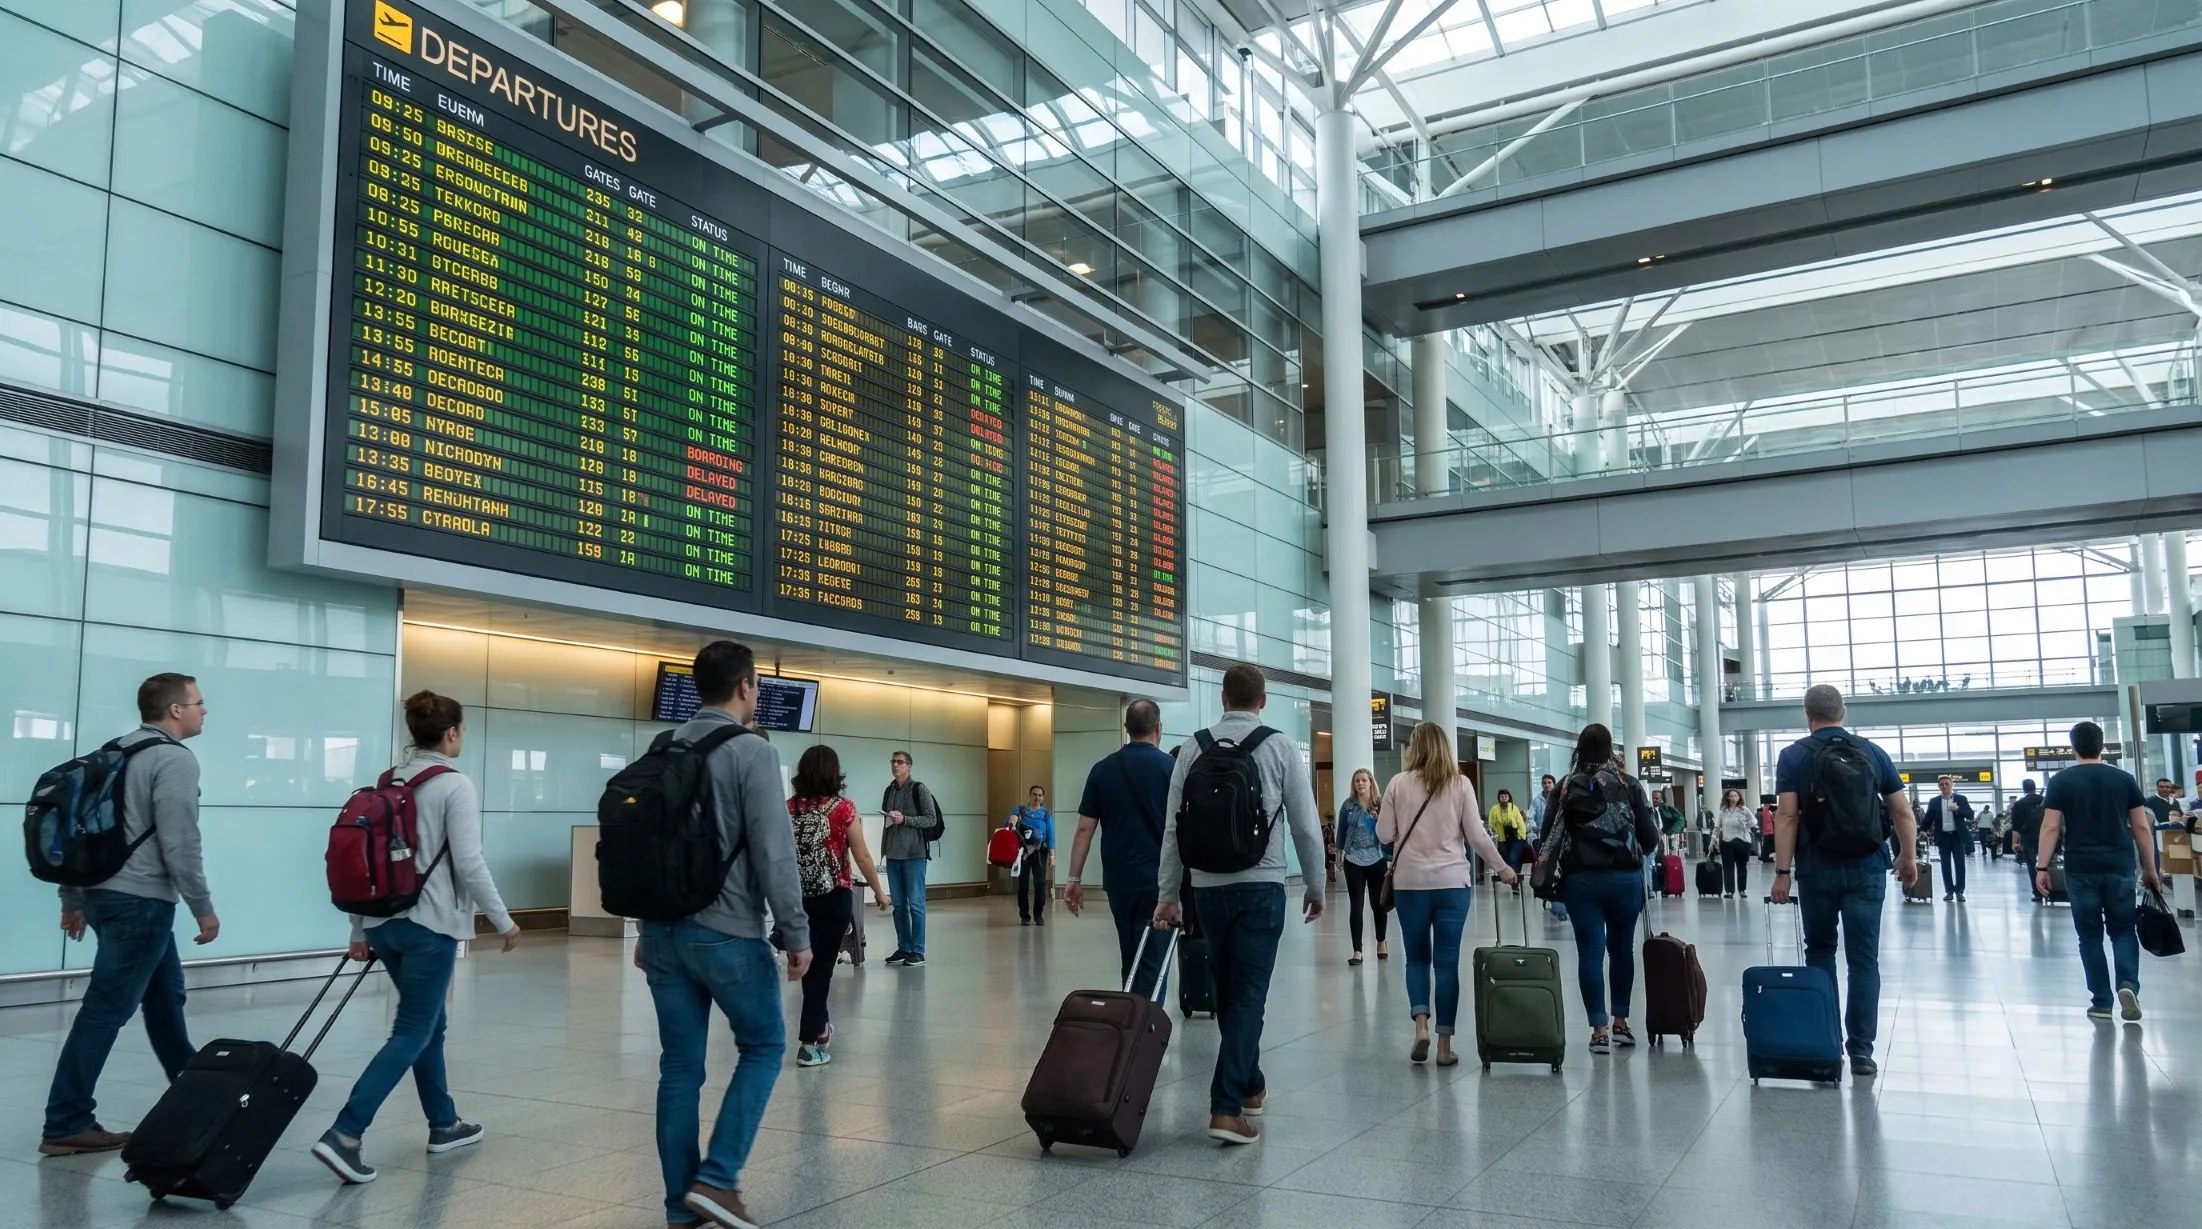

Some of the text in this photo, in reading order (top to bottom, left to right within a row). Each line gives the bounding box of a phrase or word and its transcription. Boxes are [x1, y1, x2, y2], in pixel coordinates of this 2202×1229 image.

[421, 26, 637, 163] DEPARTURES
[372, 61, 728, 242] TIME GATES GATE STATUS
[586, 188, 610, 209] 235
[627, 206, 643, 224] 32
[692, 236, 707, 253] ON
[713, 245, 739, 267] TIME
[691, 255, 706, 271] ON
[712, 264, 738, 286] TIME
[366, 231, 417, 261] 10:31
[689, 350, 704, 366] ON
[711, 357, 737, 378] TIME
[366, 254, 417, 284] 11:30
[689, 369, 704, 385] ON
[710, 376, 737, 397] TIME
[368, 207, 419, 238] 10:55
[689, 330, 705, 347] ON
[711, 338, 738, 360] TIME
[585, 270, 609, 289] 150
[690, 312, 705, 328] ON
[712, 320, 738, 341] TIME
[690, 293, 706, 309] ON
[712, 301, 738, 323] TIME
[691, 274, 706, 291] ON
[712, 282, 738, 304] TIME
[783, 258, 807, 279] TIME
[933, 330, 953, 347] GATE
[970, 347, 995, 366] STATUS
[363, 326, 414, 353] 13:55
[581, 394, 605, 412] 133
[688, 427, 703, 443] ON
[709, 433, 736, 453] TIME
[364, 302, 415, 330] 13:55
[581, 373, 606, 391] 238
[688, 407, 703, 423] ON
[709, 414, 736, 434] TIME
[365, 278, 416, 307] 12:20
[688, 388, 704, 404] ON
[710, 395, 737, 415] TIME
[358, 447, 409, 472] 13:35
[685, 524, 701, 539] ON
[707, 528, 735, 547] TIME
[686, 485, 736, 509] DELAYED
[687, 446, 743, 473] BOARDING
[687, 465, 736, 490] DELAYED
[356, 497, 407, 520] 17:55
[685, 563, 700, 578] ON
[706, 567, 734, 585] TIME
[357, 472, 408, 496] 16:45
[685, 544, 700, 559] ON
[707, 548, 734, 566] TIME
[686, 504, 701, 520] ON
[708, 509, 735, 528] TIME
